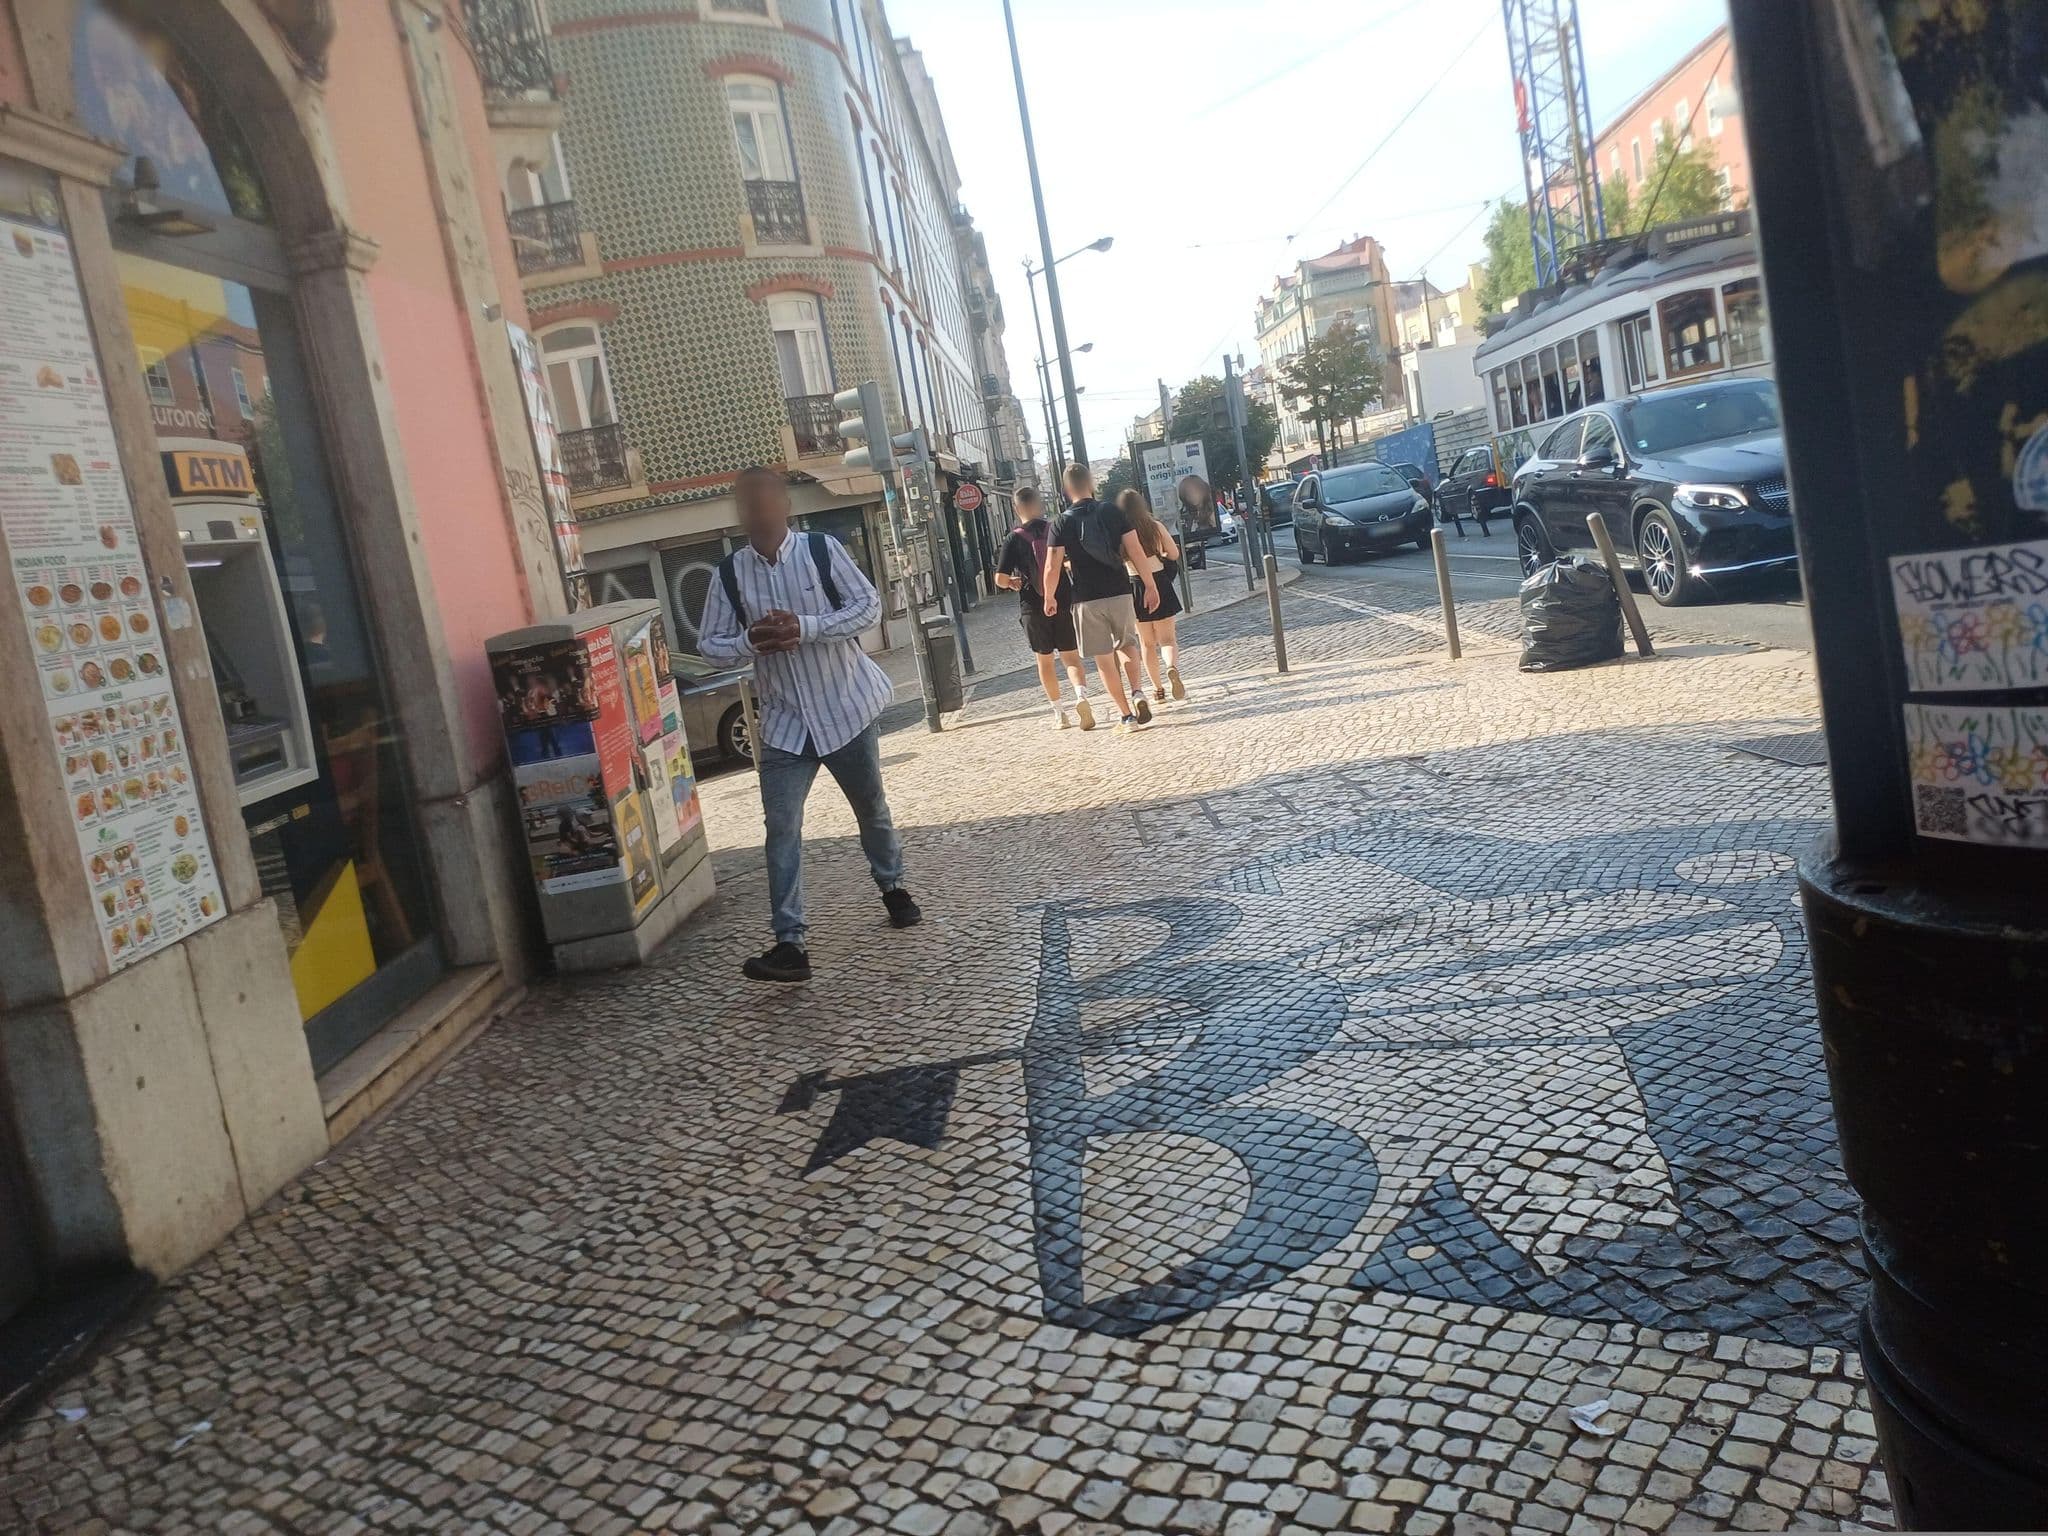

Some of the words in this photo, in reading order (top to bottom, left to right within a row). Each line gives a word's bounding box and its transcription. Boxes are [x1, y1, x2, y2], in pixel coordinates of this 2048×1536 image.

[152, 406, 217, 430] uronet
[188, 456, 248, 489] ATM
[44, 555, 67, 566] FOOD
